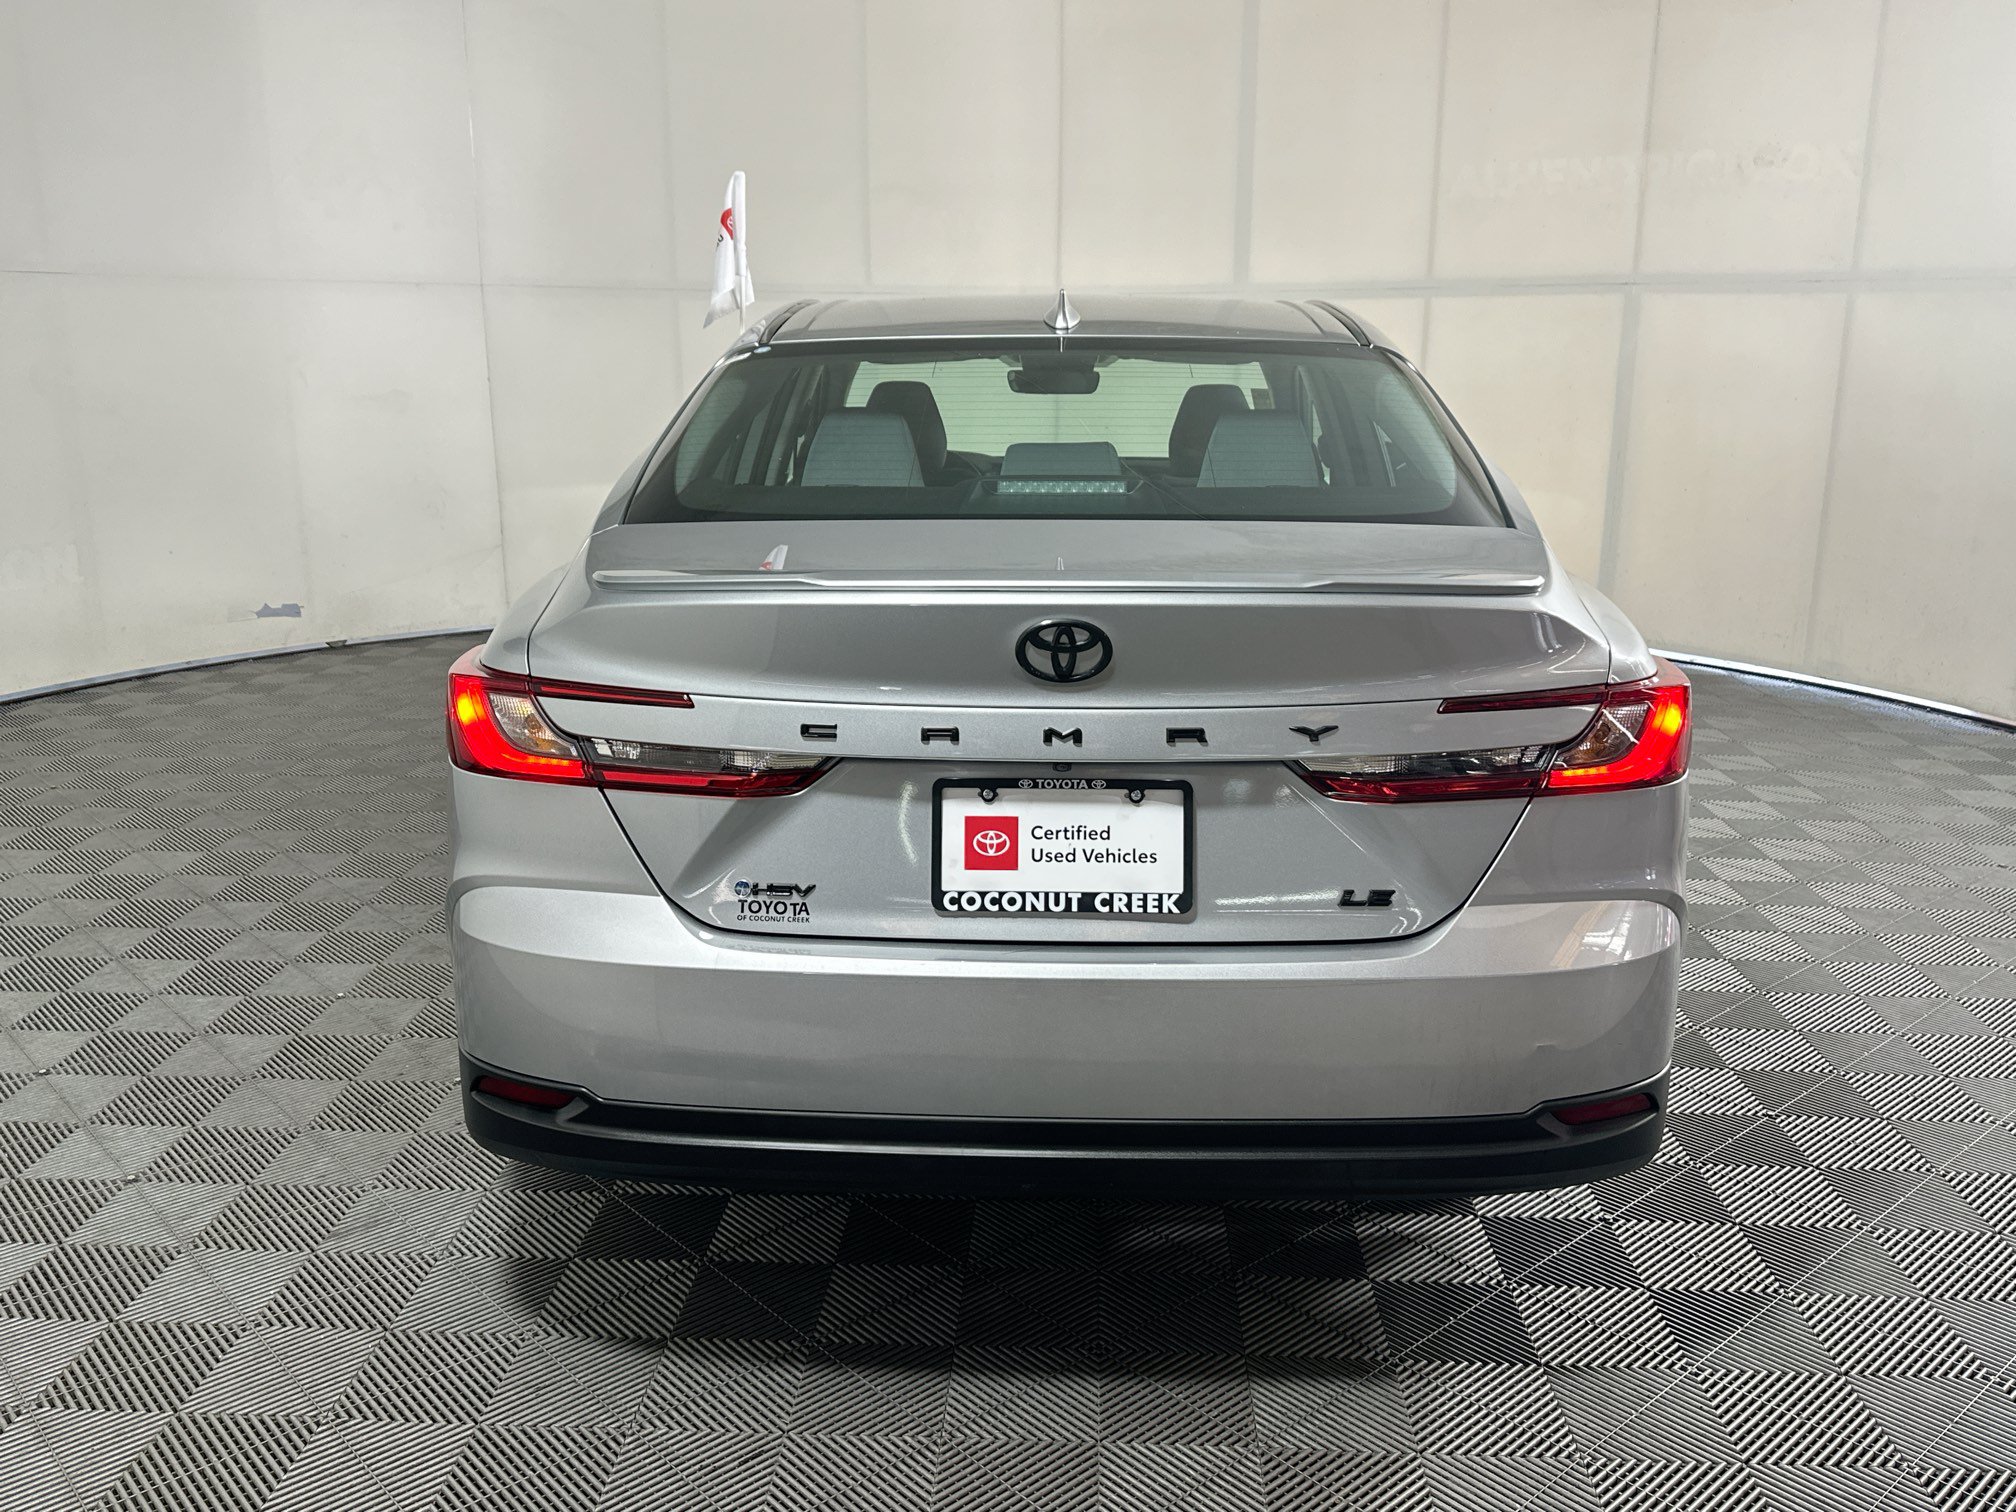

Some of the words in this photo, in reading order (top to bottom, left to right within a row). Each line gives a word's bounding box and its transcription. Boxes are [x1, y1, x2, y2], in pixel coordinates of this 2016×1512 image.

[800, 722, 1339, 745] CAMRY
[1036, 779, 1088, 790] TOYOTA
[1031, 825, 1111, 841] Certified
[1031, 848, 1076, 863] Used
[1082, 848, 1158, 864] Vehicles
[943, 891, 1082, 912] COCONUT
[1094, 893, 1180, 914] CREEK
[1338, 889, 1396, 907] LE
[738, 899, 810, 916] TOYOTA
